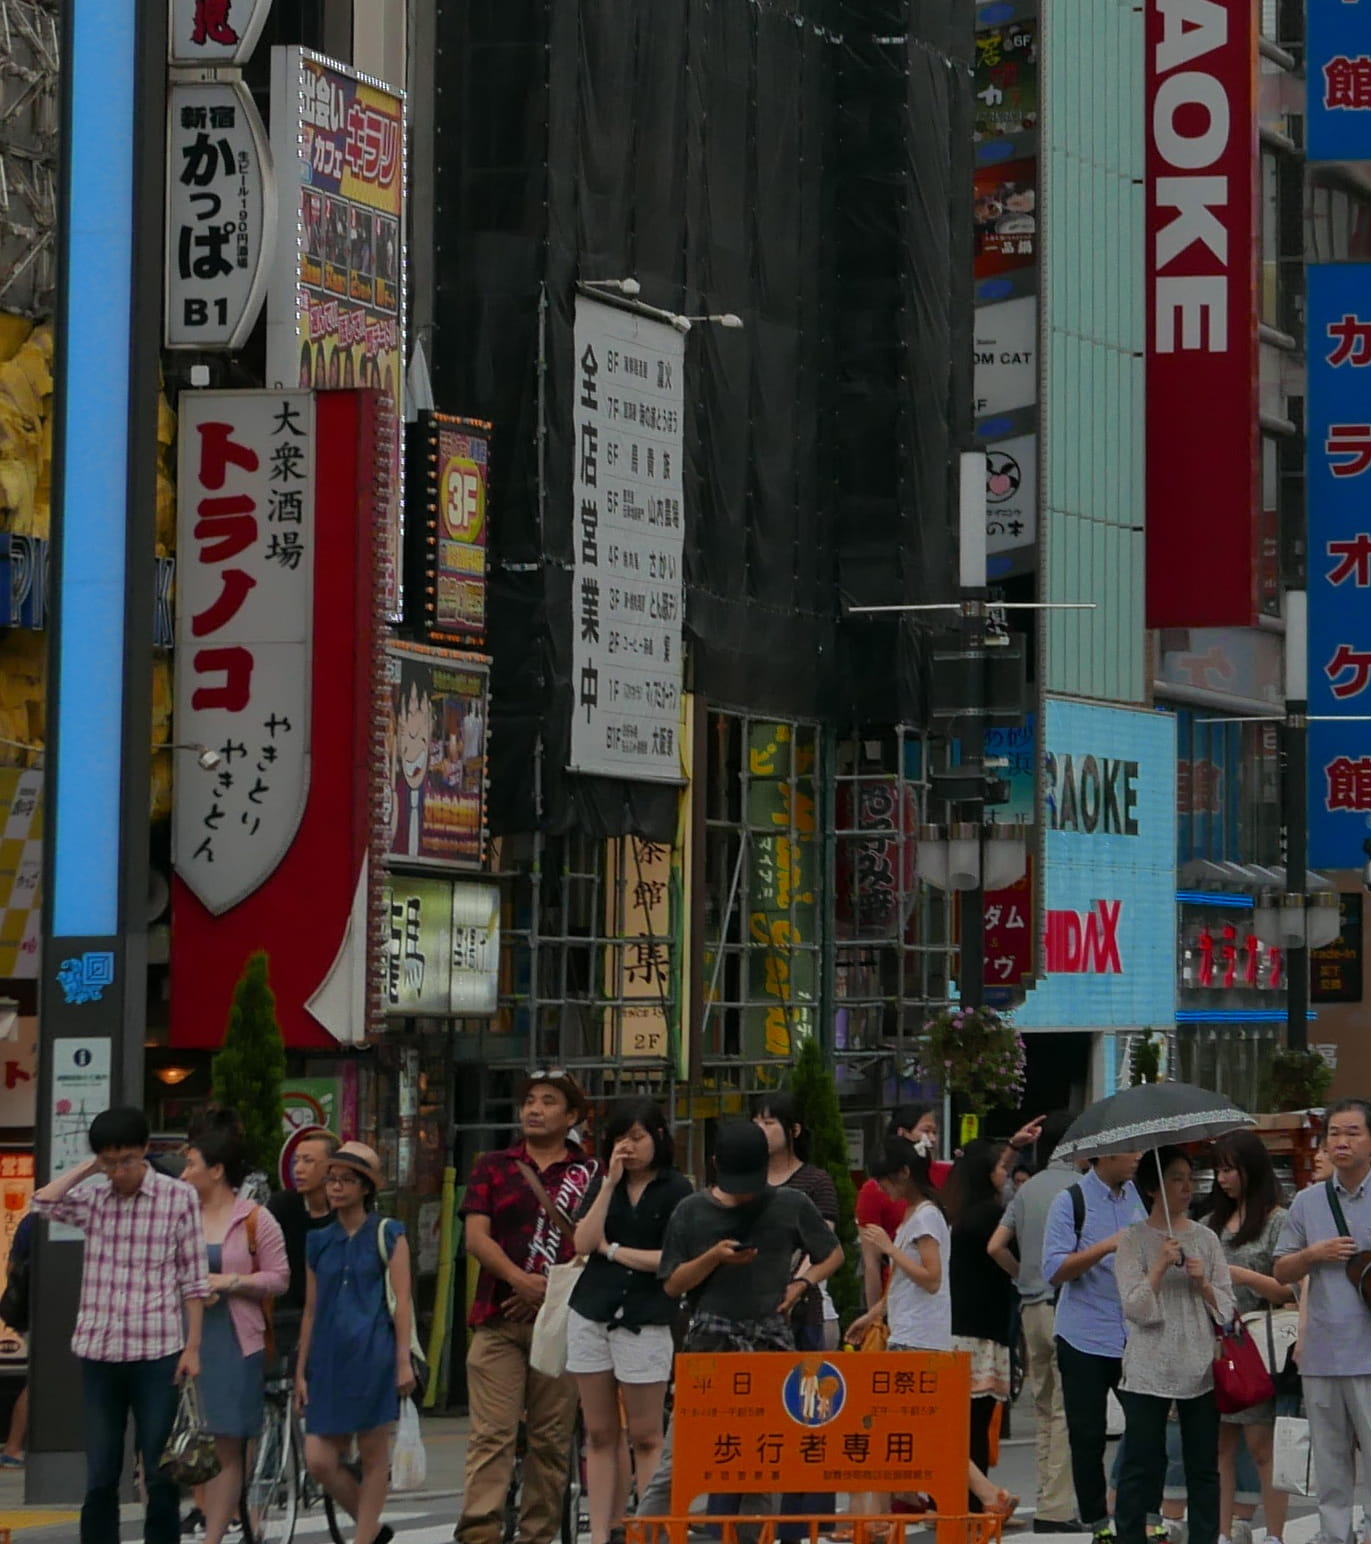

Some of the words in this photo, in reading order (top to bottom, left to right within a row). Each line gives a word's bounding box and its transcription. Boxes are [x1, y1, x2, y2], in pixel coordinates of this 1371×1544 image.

[180, 106, 236, 129] 新宿
[178, 132, 237, 280] かっぱ
[184, 298, 228, 326] B1
[1000, 352, 1032, 365] CAT
[607, 397, 619, 421] 7F
[264, 400, 309, 571] 大衆酒場
[448, 472, 478, 527] 3F
[580, 343, 599, 724] 全店営業中
[192, 421, 260, 714] トラノコ
[241, 713, 292, 838] やきとり
[634, 1033, 661, 1049] 2F
[713, 1432, 914, 1465] 歩行者専用
